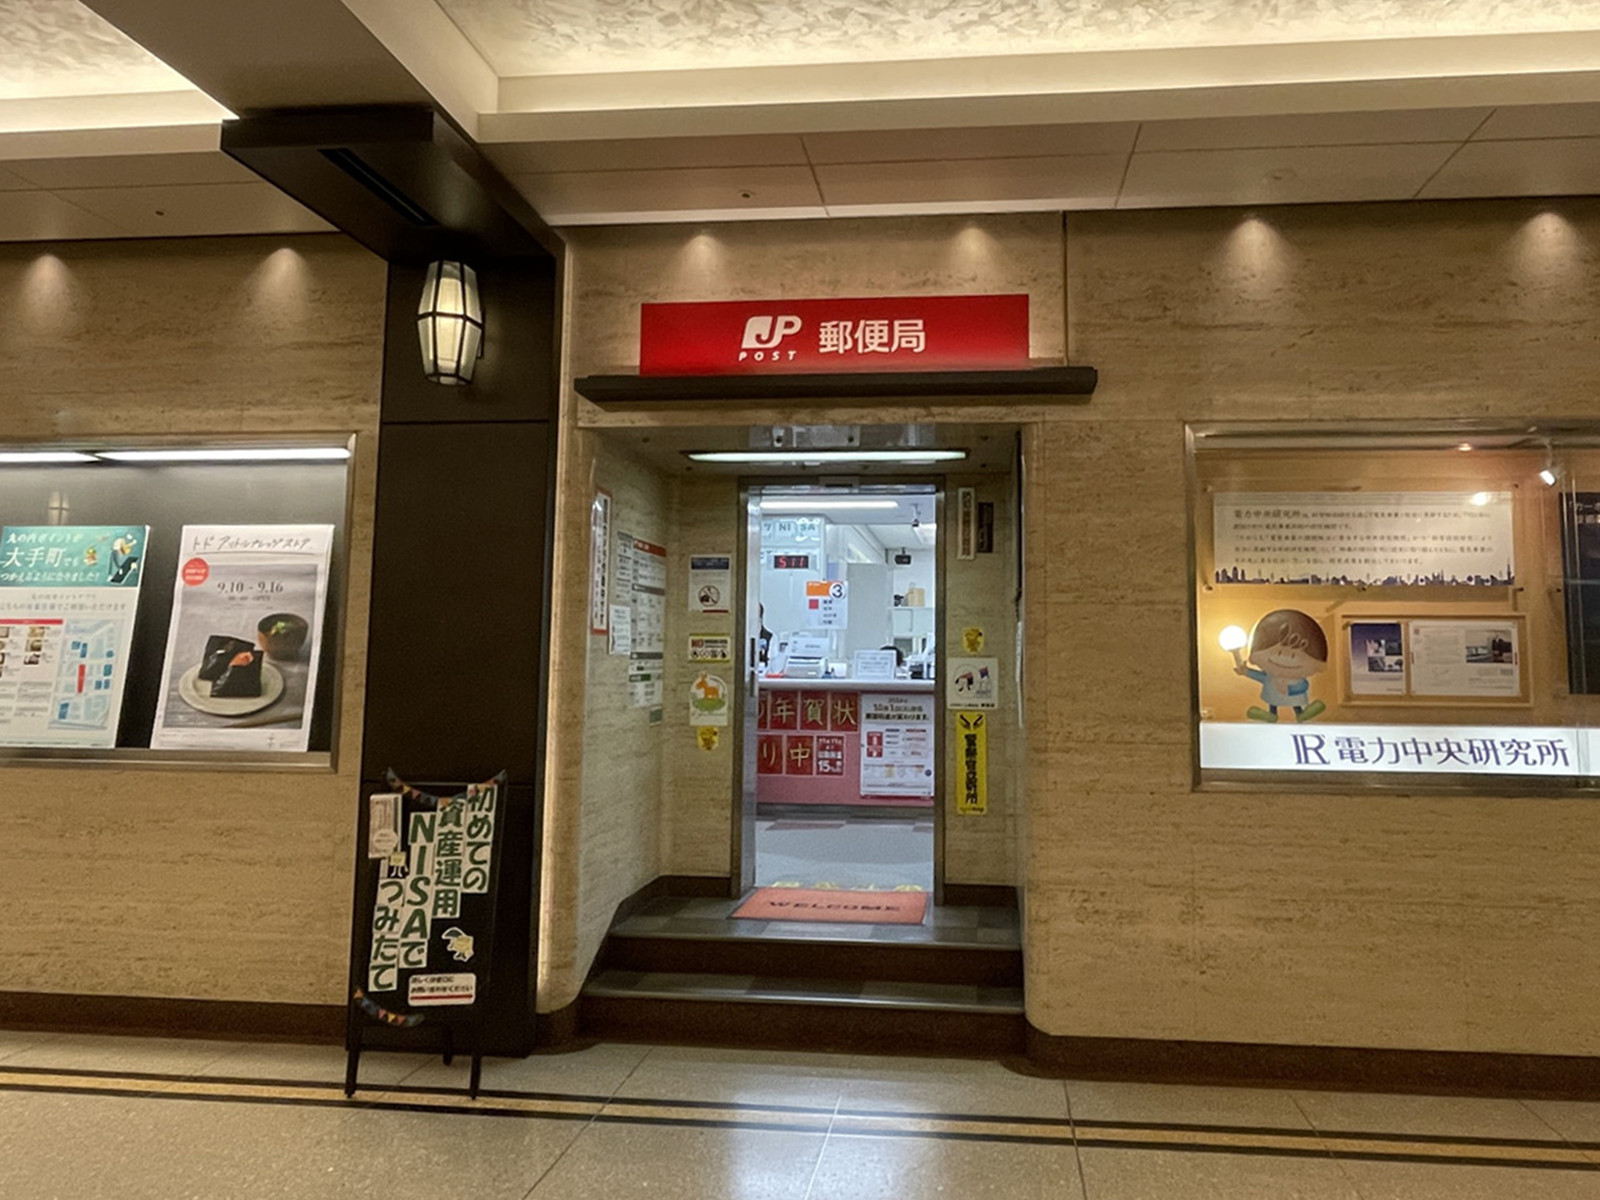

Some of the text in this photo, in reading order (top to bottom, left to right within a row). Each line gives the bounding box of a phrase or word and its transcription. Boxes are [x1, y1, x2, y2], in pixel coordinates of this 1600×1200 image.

[741, 315, 802, 349] JP
[819, 319, 926, 354] 郵便局
[738, 351, 797, 361] POST
[2, 546, 79, 568] 大手町でも
[217, 581, 244, 594] 9.10
[257, 581, 284, 594] 9.16
[831, 584, 843, 598] 3
[1334, 736, 1571, 767] 電力中央研究所
[462, 787, 493, 892] 初めての
[432, 801, 464, 916] 資産運用
[401, 814, 437, 967] NISAで
[769, 902, 900, 912] WELCOME
[370, 881, 404, 989] つみたて
